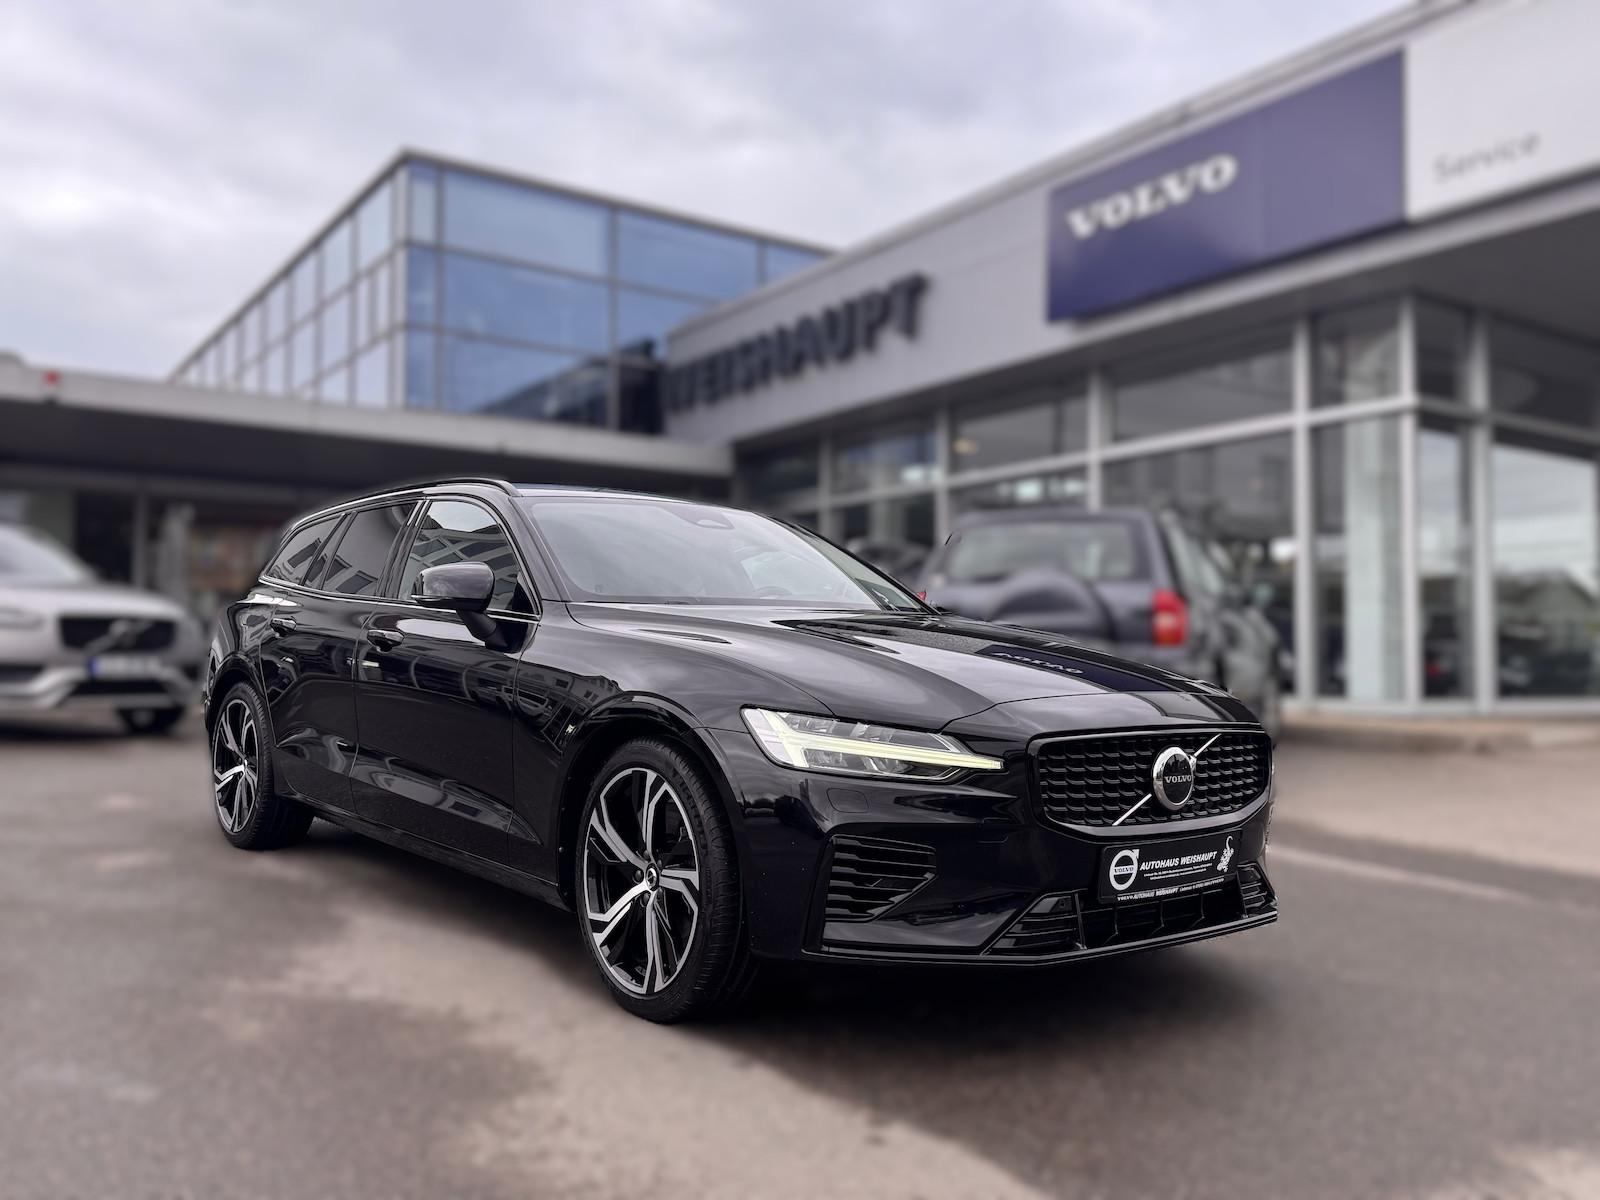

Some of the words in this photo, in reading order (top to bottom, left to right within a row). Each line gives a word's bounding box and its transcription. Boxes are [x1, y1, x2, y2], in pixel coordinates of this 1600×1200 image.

[1432, 131, 1542, 185] Service
[1064, 152, 1239, 240] VOLVO
[1164, 775, 1192, 783] VOLVO
[1114, 866, 1134, 874] VOLVO
[1140, 858, 1180, 870] AUTOHAUS
[1180, 851, 1217, 865] WEISHAUPT
